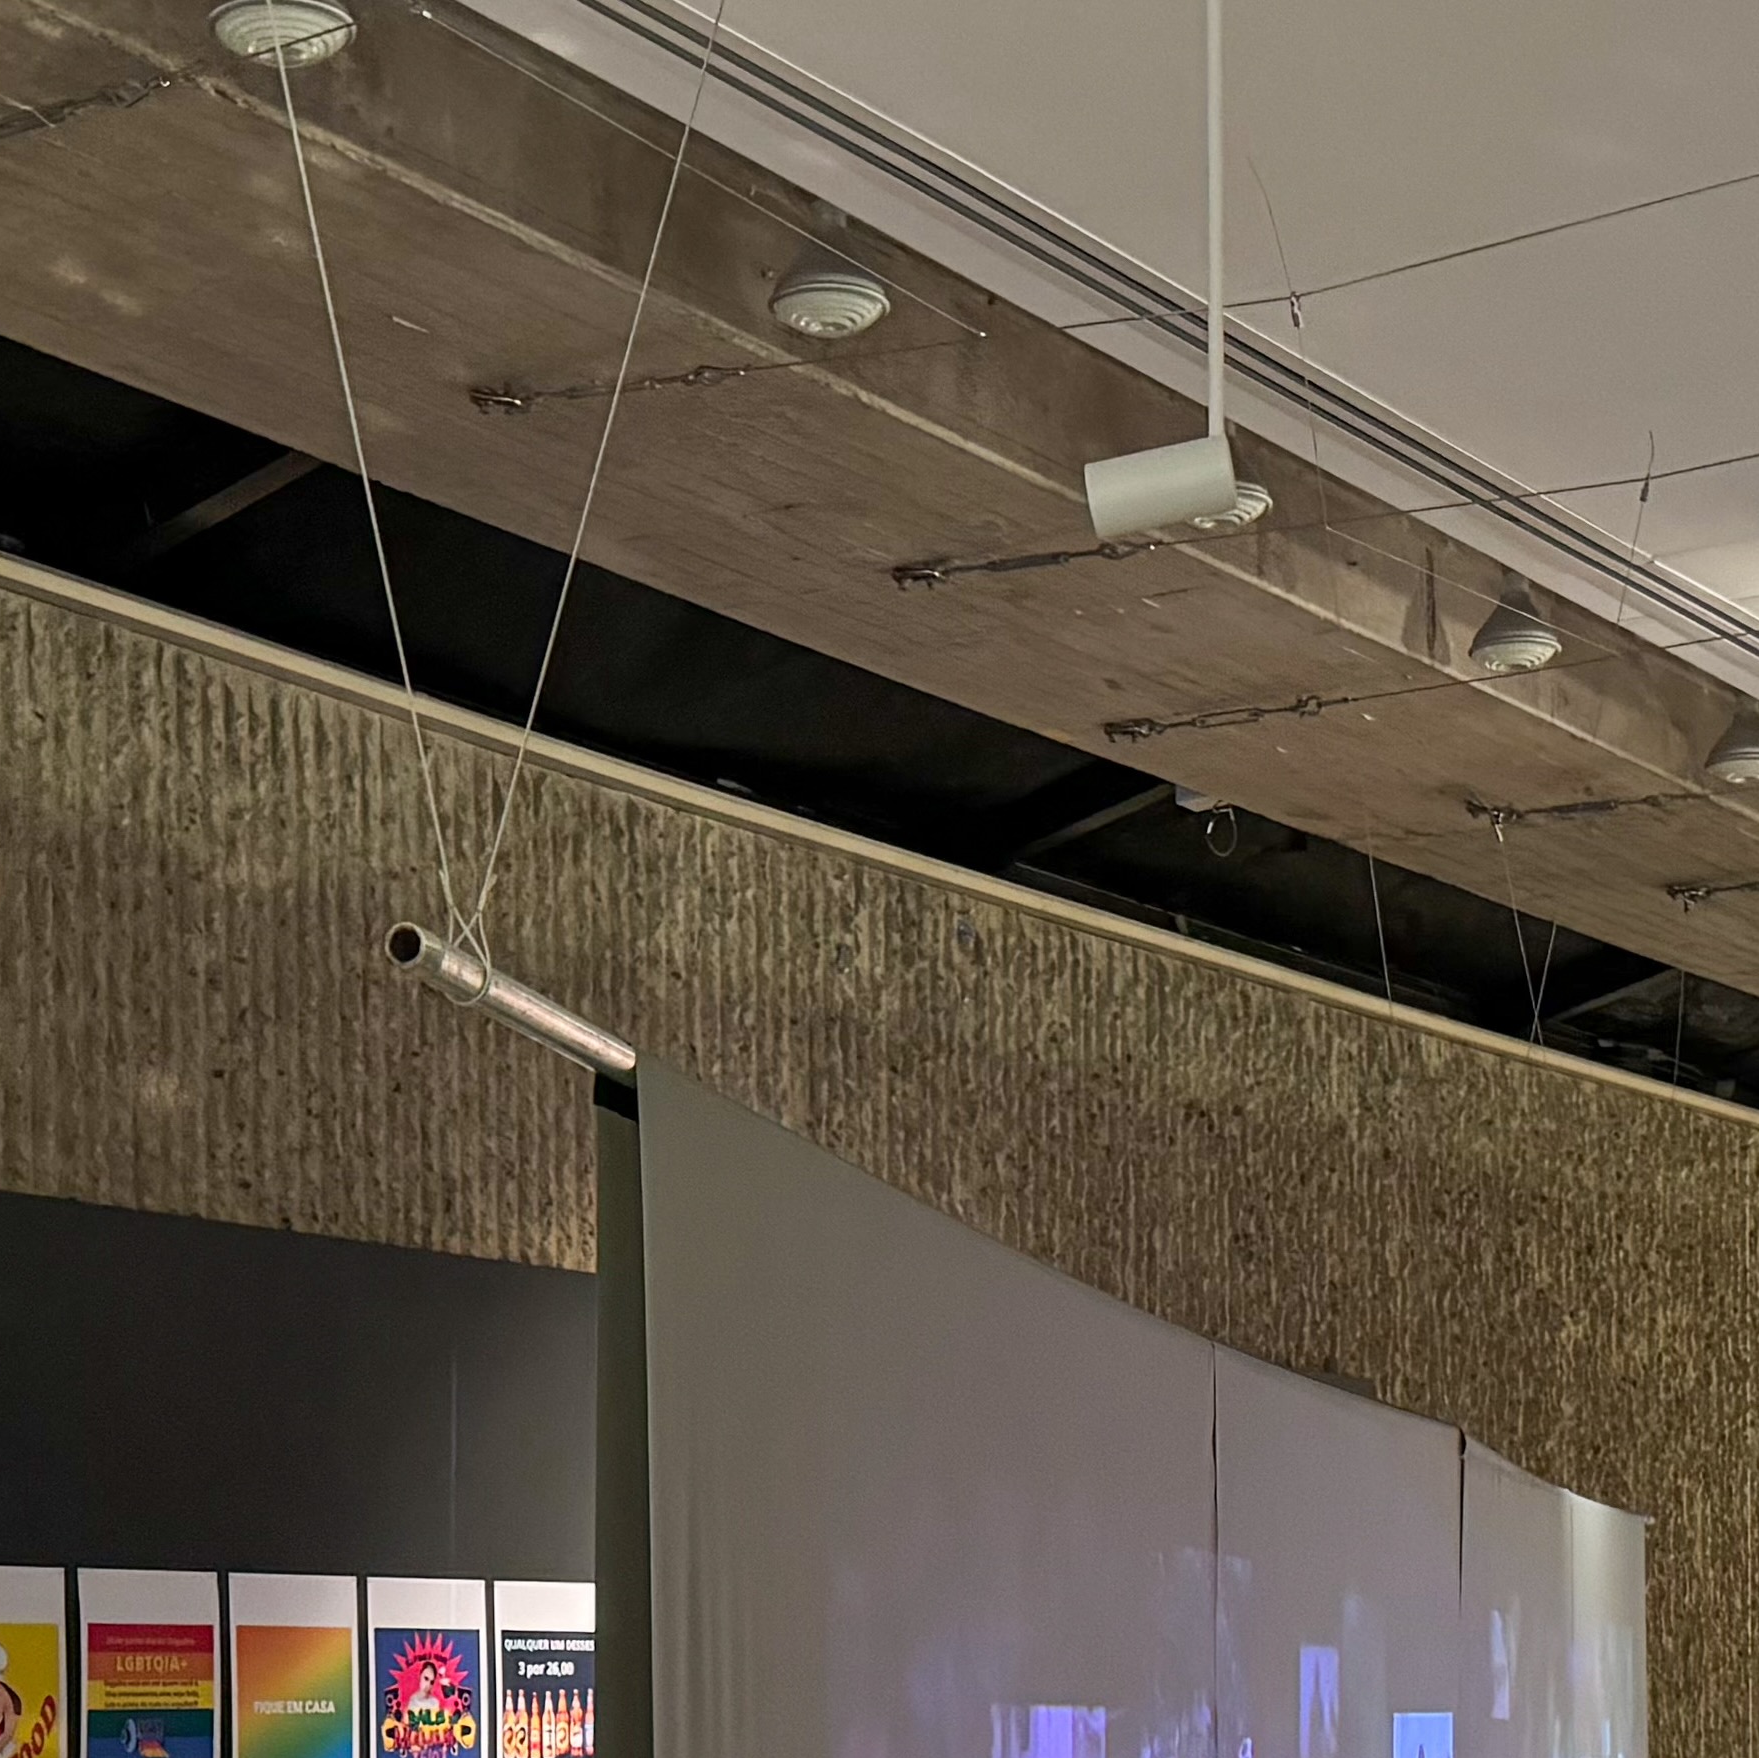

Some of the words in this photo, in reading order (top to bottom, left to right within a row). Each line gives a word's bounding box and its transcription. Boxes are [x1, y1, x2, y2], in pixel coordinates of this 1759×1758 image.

[504, 1638, 549, 1652] QUALQUER
[115, 1655, 188, 1674] LGBTQIA+
[518, 1661, 525, 1675] 3
[526, 1664, 545, 1679] por
[304, 1700, 336, 1714] CASA
